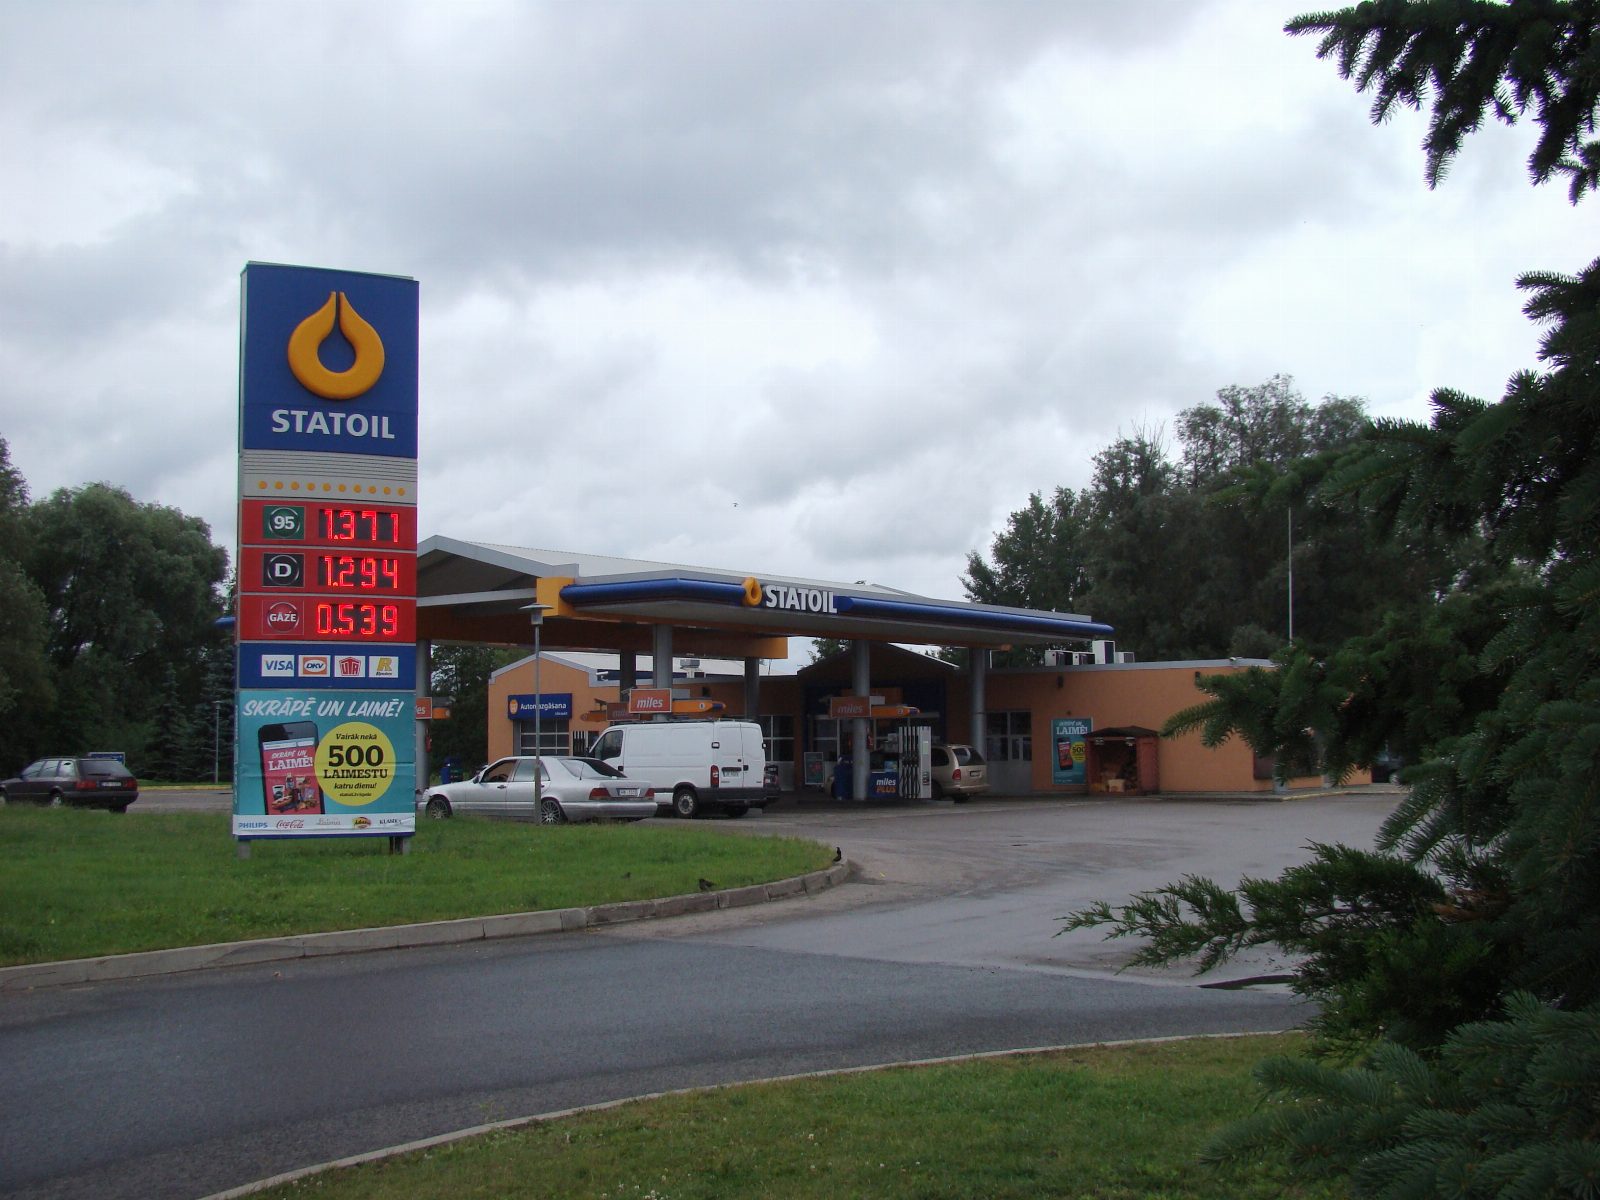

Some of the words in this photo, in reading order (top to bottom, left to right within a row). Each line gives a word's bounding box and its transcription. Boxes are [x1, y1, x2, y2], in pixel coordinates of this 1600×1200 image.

[272, 409, 395, 439] STATOIL
[273, 515, 295, 530] 95
[323, 508, 399, 543] 1.371
[274, 563, 292, 577] D
[323, 555, 398, 589] 1.294
[765, 584, 838, 614] STATOIL
[316, 603, 399, 636] 0.539
[265, 660, 294, 671] VISA
[317, 700, 345, 717] UN
[347, 698, 405, 718] LAIMĒ!
[636, 697, 664, 708] miles
[328, 745, 384, 767] 500
[323, 768, 388, 779] LAIMESTU
[875, 777, 897, 786] miles
[354, 782, 377, 790] dienu!
